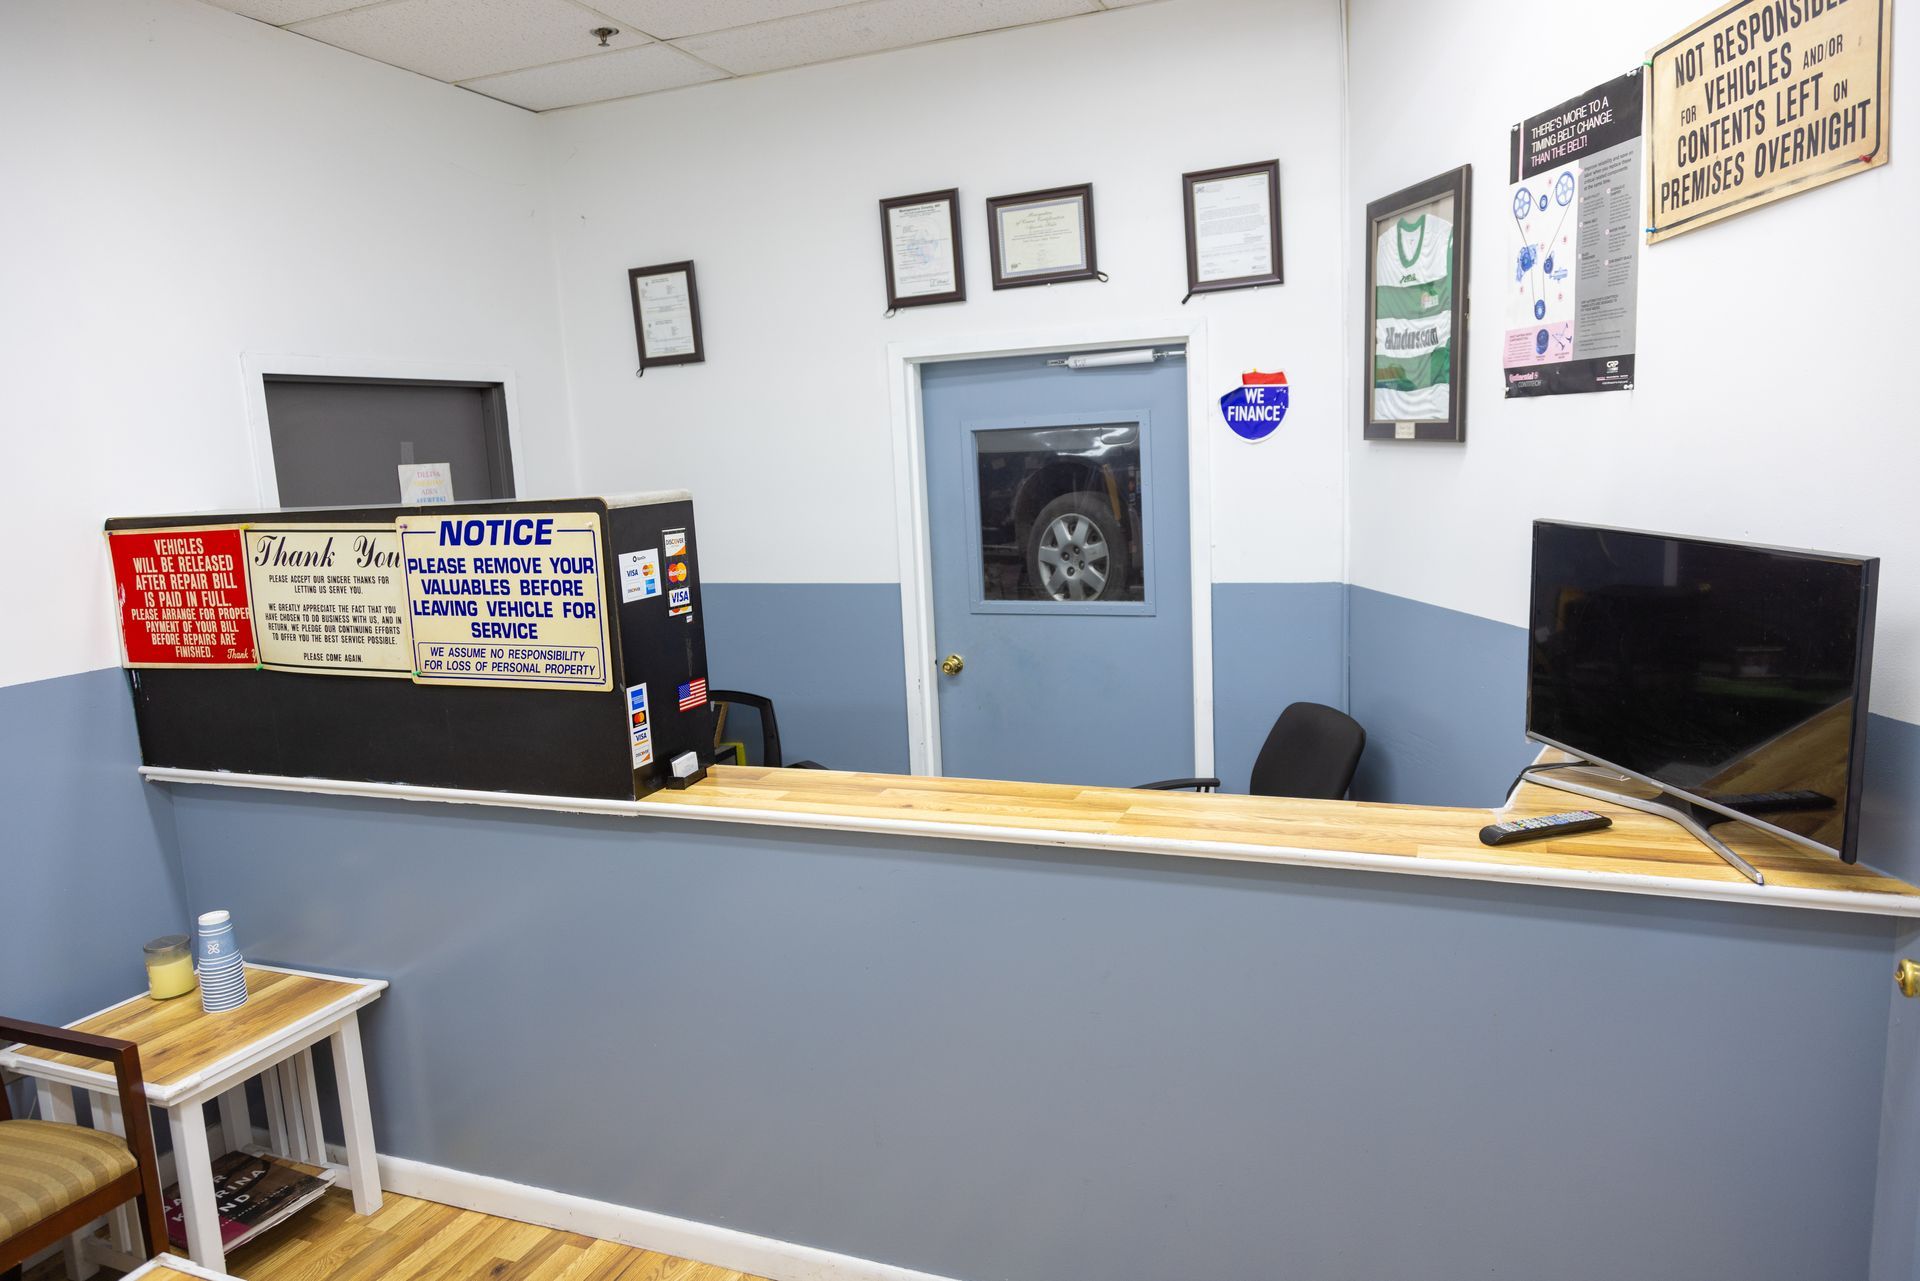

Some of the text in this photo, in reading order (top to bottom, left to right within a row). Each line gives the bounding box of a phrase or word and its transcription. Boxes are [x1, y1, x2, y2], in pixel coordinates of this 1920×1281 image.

[1674, 0, 1848, 88] NOT RESPONSI
[1680, 34, 1843, 127] FOR VEHICLES AND/OR
[1531, 96, 1609, 140] THERE'S MORE TO A
[1677, 72, 1847, 168] CONTENTS LEFT ON
[1531, 109, 1613, 153] TIMING BELT CHANGE
[1530, 135, 1588, 167] THAN THE BELT!
[1660, 151, 1745, 214] PREMISES
[1754, 98, 1871, 179] OVERNIGHT
[1244, 388, 1265, 404] WE
[1227, 405, 1281, 422] FINANCE
[439, 518, 554, 546] NOTICE
[154, 538, 204, 555] VEHICLES
[254, 535, 401, 568] Thank You
[133, 555, 234, 573] WILL BE RELEASED
[407, 557, 594, 574] PLEASE REMOVE YOUR
[268, 575, 390, 585] PLEASE ACCEPT OUR SINCERE THANKS FOR
[626, 568, 639, 577] VISA
[135, 572, 238, 591] AFTER REPAIR BILL
[421, 579, 584, 596] VALUABLES BEFORE
[294, 585, 363, 595] LETTING US SERVE YOU.
[671, 590, 689, 603] VISA
[144, 590, 232, 607] IS PAID IN FULL.
[131, 607, 250, 621] PLEASE ARRANGE FOR PROPER
[268, 603, 396, 614] WE GREATLY APPRECIATE THE FACT THAT YOU
[413, 600, 596, 619] LEAVING VEHICLE FOR
[145, 620, 240, 633] PAYMENT OF YOUR BILL
[265, 613, 277, 621] HAVE
[279, 613, 301, 622] CHOSEN
[302, 614, 310, 622] TO
[312, 614, 320, 623] DO
[321, 614, 350, 623] BUSINESS
[352, 615, 367, 624] WITH
[382, 616, 394, 624] AND
[395, 616, 402, 625] IN
[291, 623, 300, 632] WE
[301, 624, 322, 633] PLEDGE
[324, 624, 336, 633] OUR
[338, 625, 373, 634] CONTINUING
[375, 625, 401, 635] EFFORTS
[471, 622, 538, 639] SERVICE
[151, 633, 237, 645] BEFORE REPAIRS ARE
[272, 632, 398, 645] TO OFFER YOU THE BEST SERVICE POSSIBLE.
[175, 646, 214, 658] FINISHED.
[227, 648, 249, 660] Thank
[303, 653, 364, 663] PLEASE COME AGAIN.
[430, 646, 585, 661] WE ASSUME NO RESPONSIBILITY
[424, 660, 596, 676] FOR LOSS OF PERSONAL PROPERTY
[635, 732, 647, 742] VISA
